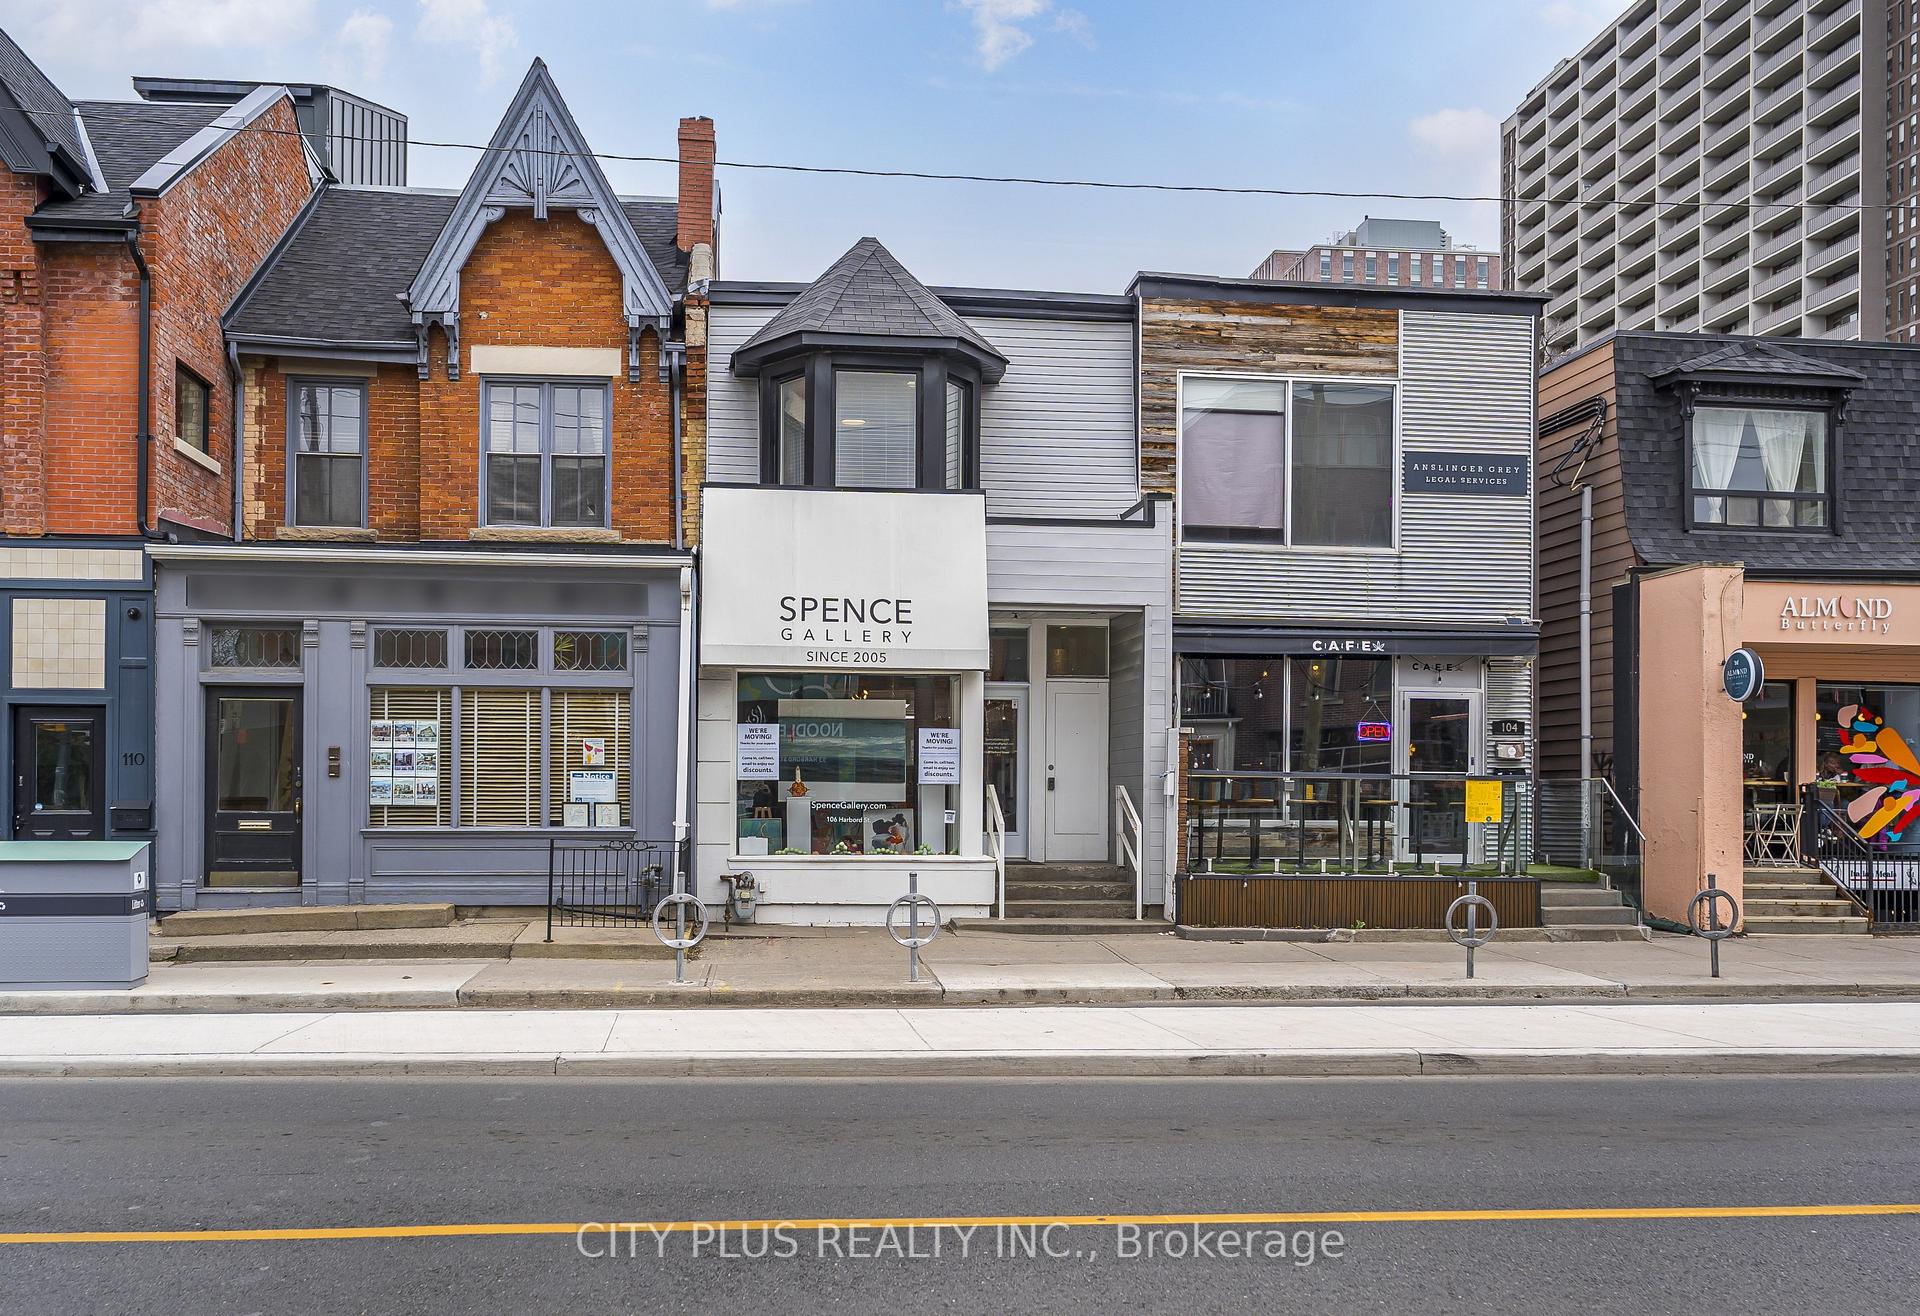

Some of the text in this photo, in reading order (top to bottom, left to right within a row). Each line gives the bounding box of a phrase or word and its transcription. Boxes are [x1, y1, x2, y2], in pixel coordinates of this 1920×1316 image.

[1413, 463, 1520, 474] ANSLINGER GREY
[1460, 477, 1507, 485] SERVICES
[780, 596, 913, 625] SPENCE
[1781, 618, 1890, 634] Butterfly
[781, 627, 912, 643] GALLERY
[1312, 640, 1371, 652] CAFE
[806, 651, 887, 663] SINCE 2005
[1412, 662, 1453, 672] CAFE
[1360, 725, 1389, 737] OPEN
[1501, 722, 1518, 733] 104
[122, 752, 145, 766] 110
[584, 772, 610, 780] Notice
[811, 801, 887, 811] SpenceGallery.com
